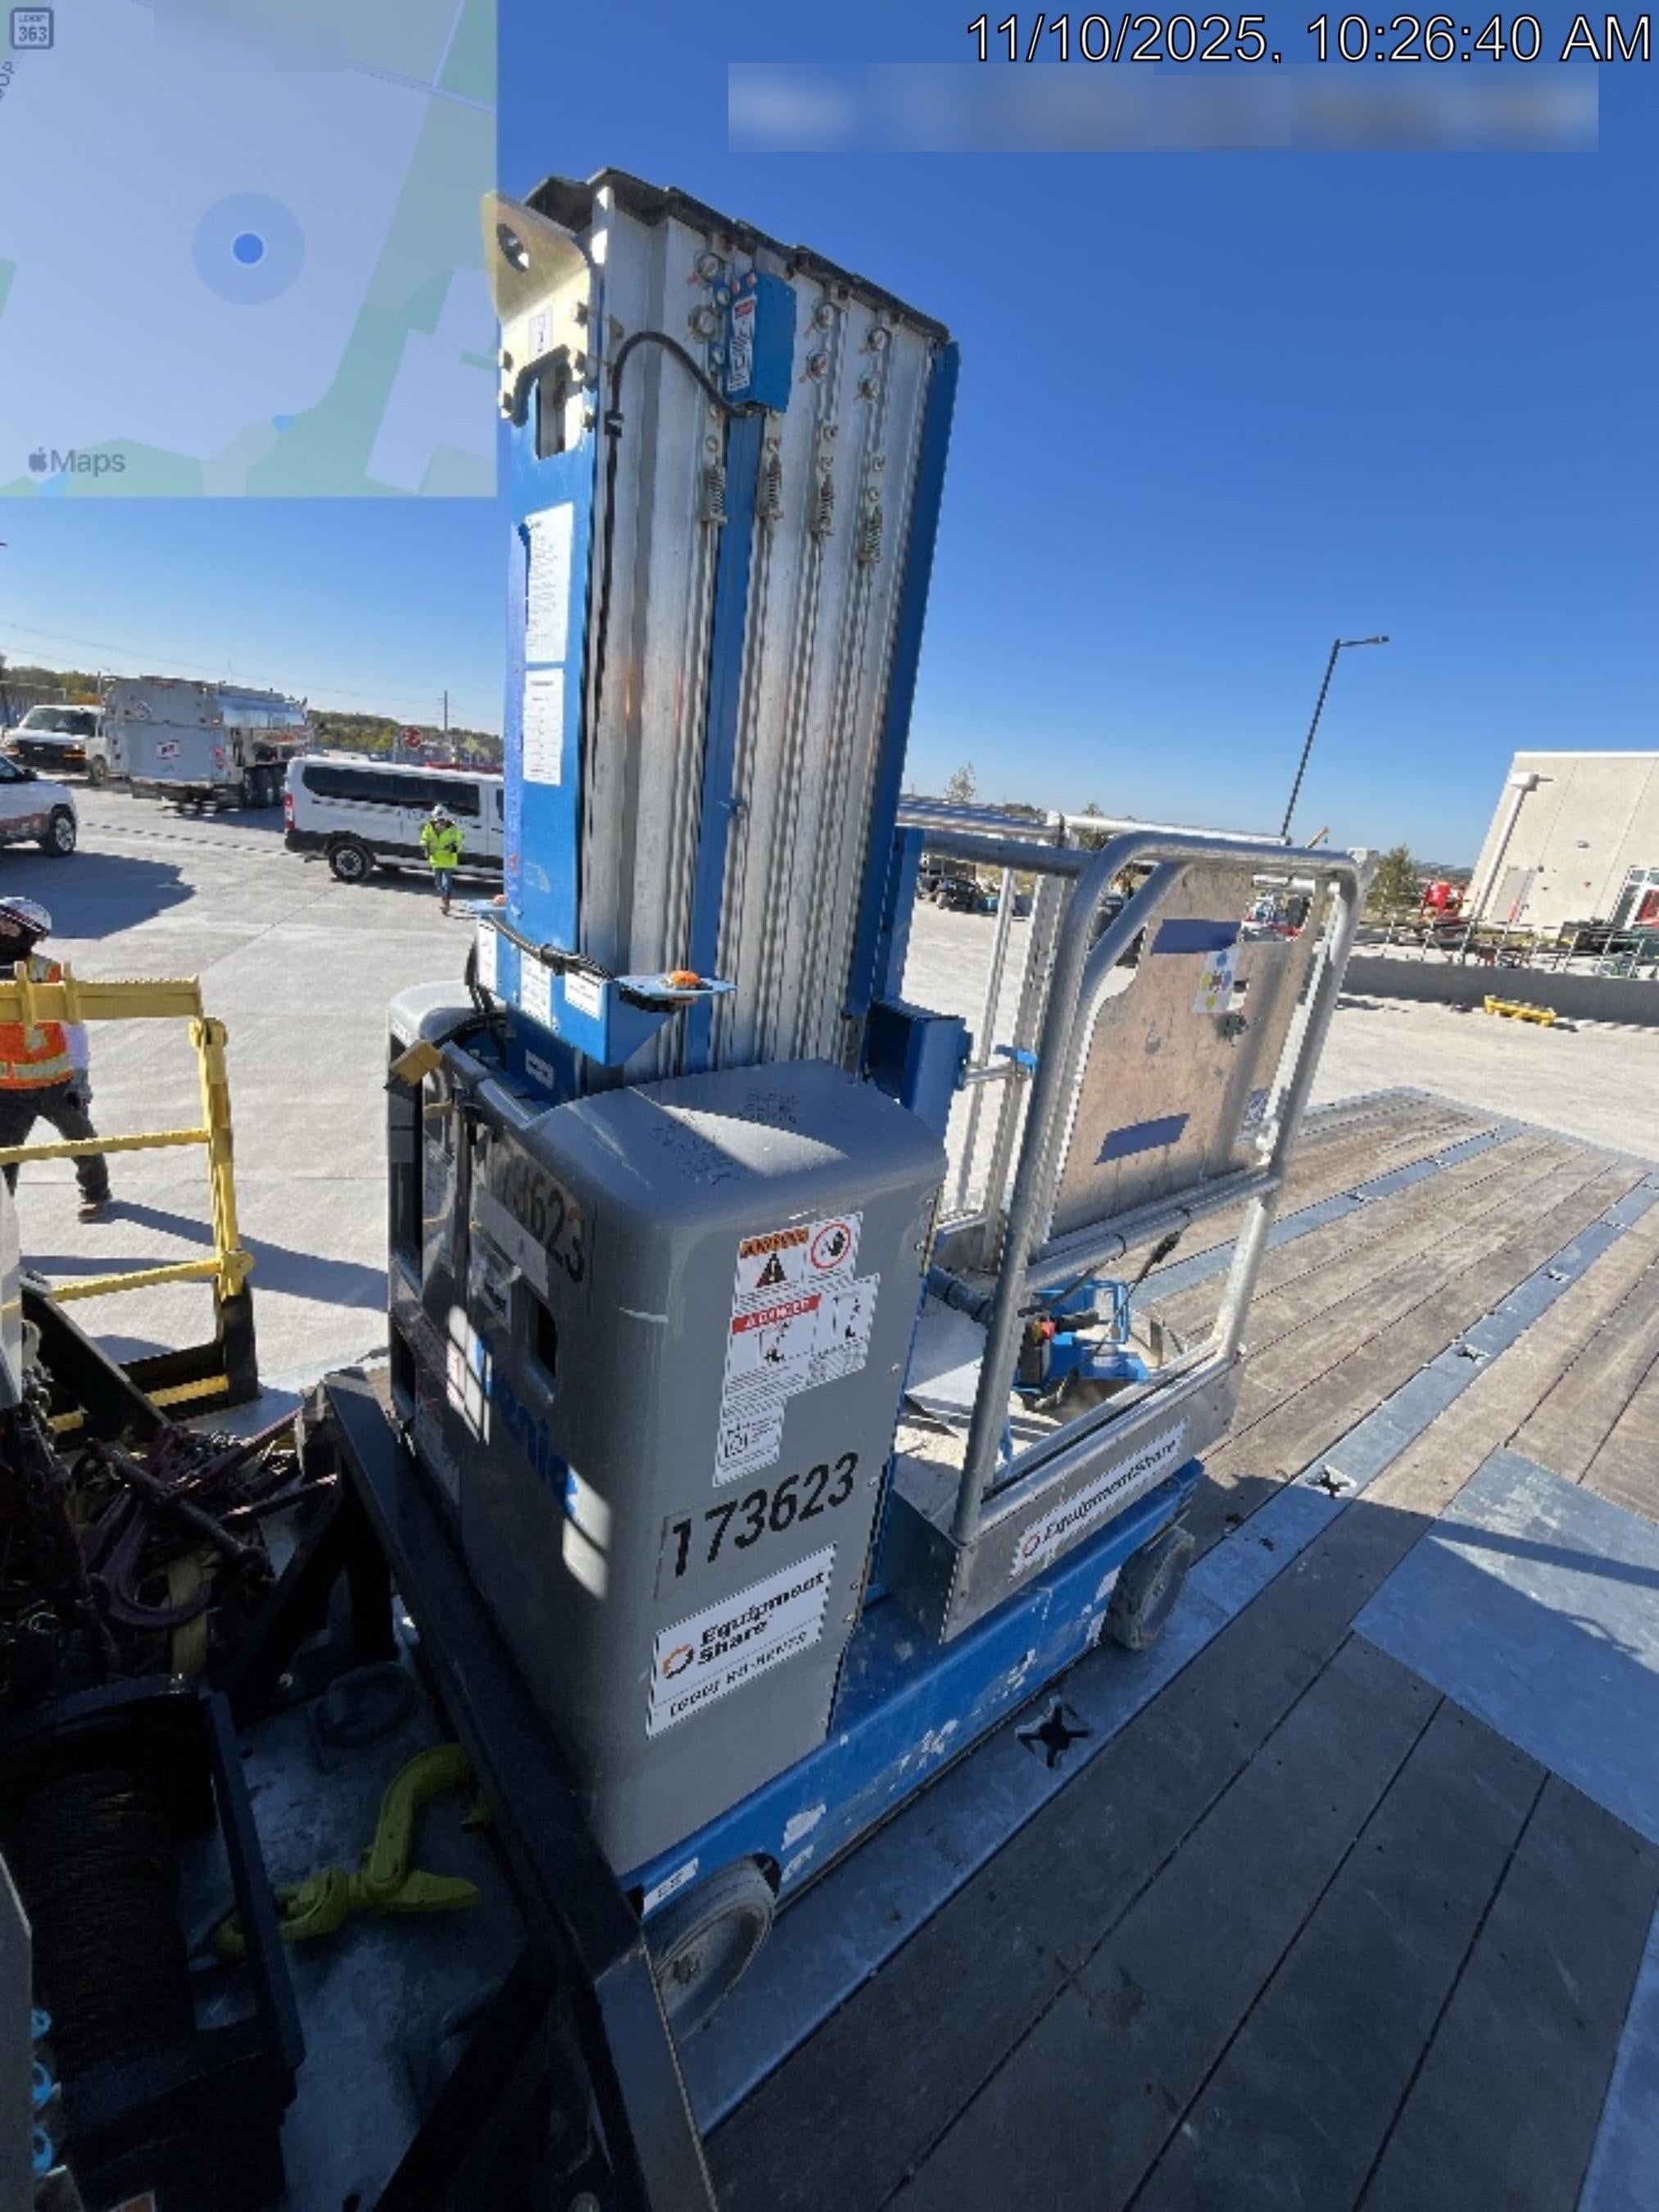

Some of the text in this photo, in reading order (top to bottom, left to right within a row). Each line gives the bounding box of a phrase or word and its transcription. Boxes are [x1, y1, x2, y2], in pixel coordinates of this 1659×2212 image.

[672, 1452, 859, 1578] 173623
[697, 1619, 768, 1666] Share
[700, 1571, 827, 1648] Equipment
